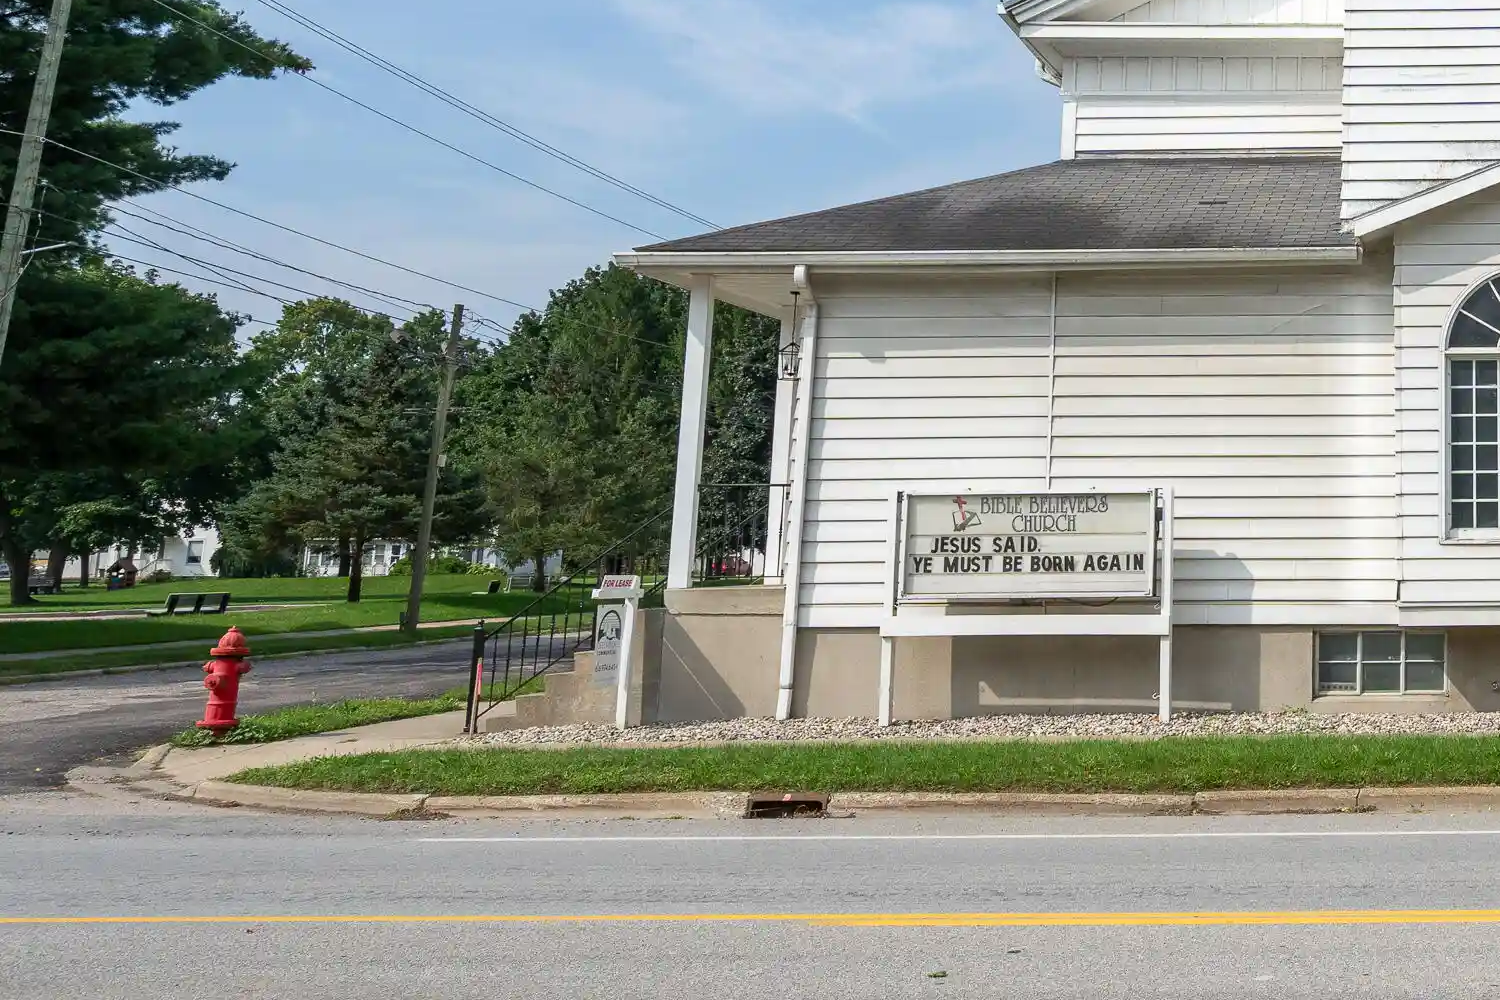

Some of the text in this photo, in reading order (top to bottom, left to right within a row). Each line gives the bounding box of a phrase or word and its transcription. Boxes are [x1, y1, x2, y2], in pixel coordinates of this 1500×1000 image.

[980, 495, 1108, 514] BIBLE BELIEVERS
[1012, 514, 1077, 532] CHURCH
[931, 536, 981, 553] JESUS
[913, 553, 1144, 573] YE MUST BE BORN AGAIN
[603, 579, 632, 588] FOR LEASE
